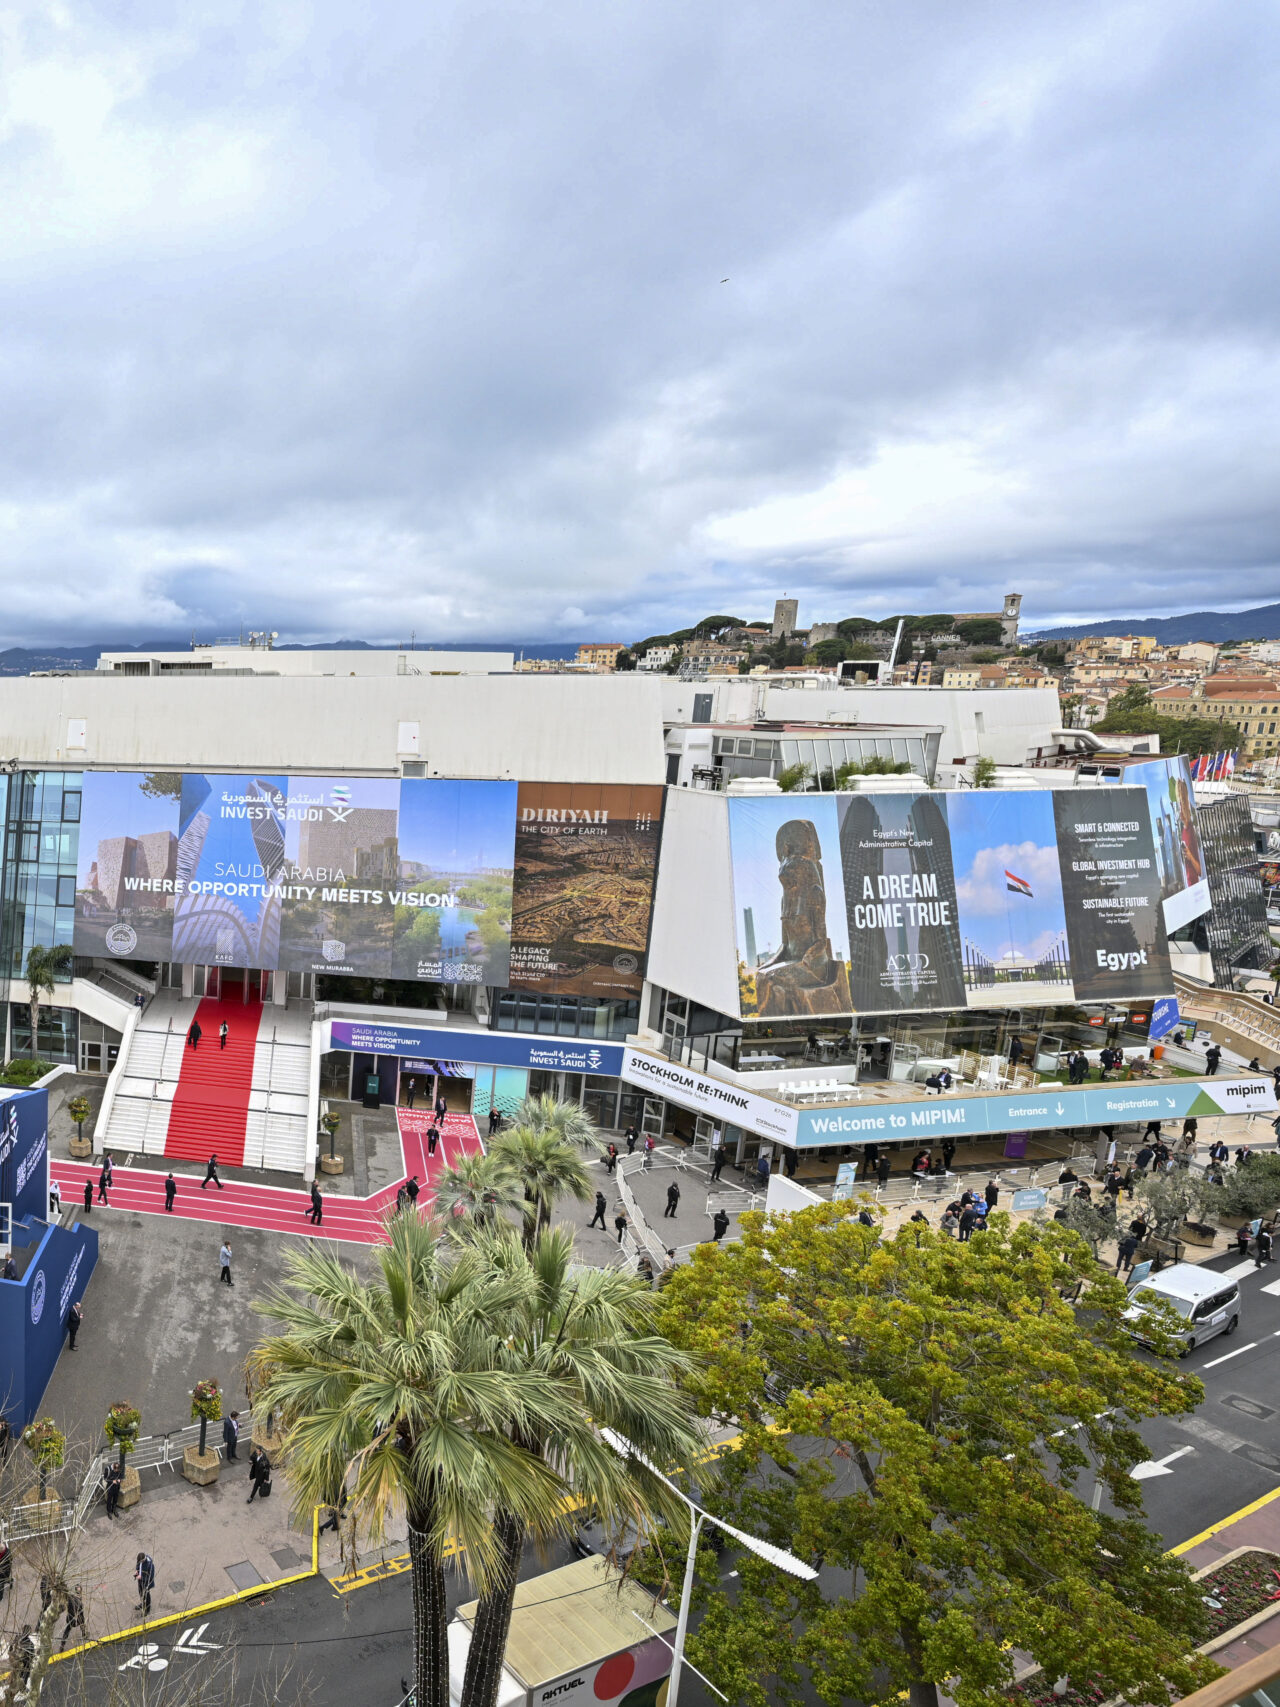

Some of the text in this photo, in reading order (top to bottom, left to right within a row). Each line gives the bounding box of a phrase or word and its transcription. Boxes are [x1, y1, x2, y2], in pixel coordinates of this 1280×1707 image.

[220, 806, 323, 821] INVEST SAUDI
[521, 807, 609, 824] DIRIYAH
[521, 825, 607, 836] THE CITY OF EARTH
[873, 829, 898, 838] Egypt's
[1075, 823, 1096, 833] SMART
[1103, 822, 1140, 832] CONNECTED
[859, 838, 933, 848] Administrative Capital
[1072, 859, 1150, 871] GLOBAL INVESTMENT HUB
[214, 862, 347, 883] SAUDI ARABIA
[863, 873, 938, 899] A DREAM
[124, 877, 455, 908] WHERE OPPORTUNITY MEETS VISION
[1082, 897, 1149, 909] SUSTAINABLE FUTURE
[854, 902, 951, 929] COME TRUE
[518, 947, 551, 955] LEGACY
[510, 953, 549, 962] SHAPING
[1096, 949, 1147, 971] Egypt
[527, 962, 558, 970] FUTURE
[374, 1029, 398, 1037] ARABIA
[375, 1036, 421, 1045] OPPORTUNITY
[529, 1056, 586, 1068] INVEST SAUDI
[631, 1057, 750, 1110] STOCKHOLM RE:THINK
[1226, 1085, 1265, 1098] mipim
[1106, 1099, 1159, 1111] Registration
[1008, 1106, 1048, 1117] Entrance
[810, 1108, 965, 1134] Welcome to MIPIM!
[542, 1677, 585, 1701] AKTUEL
